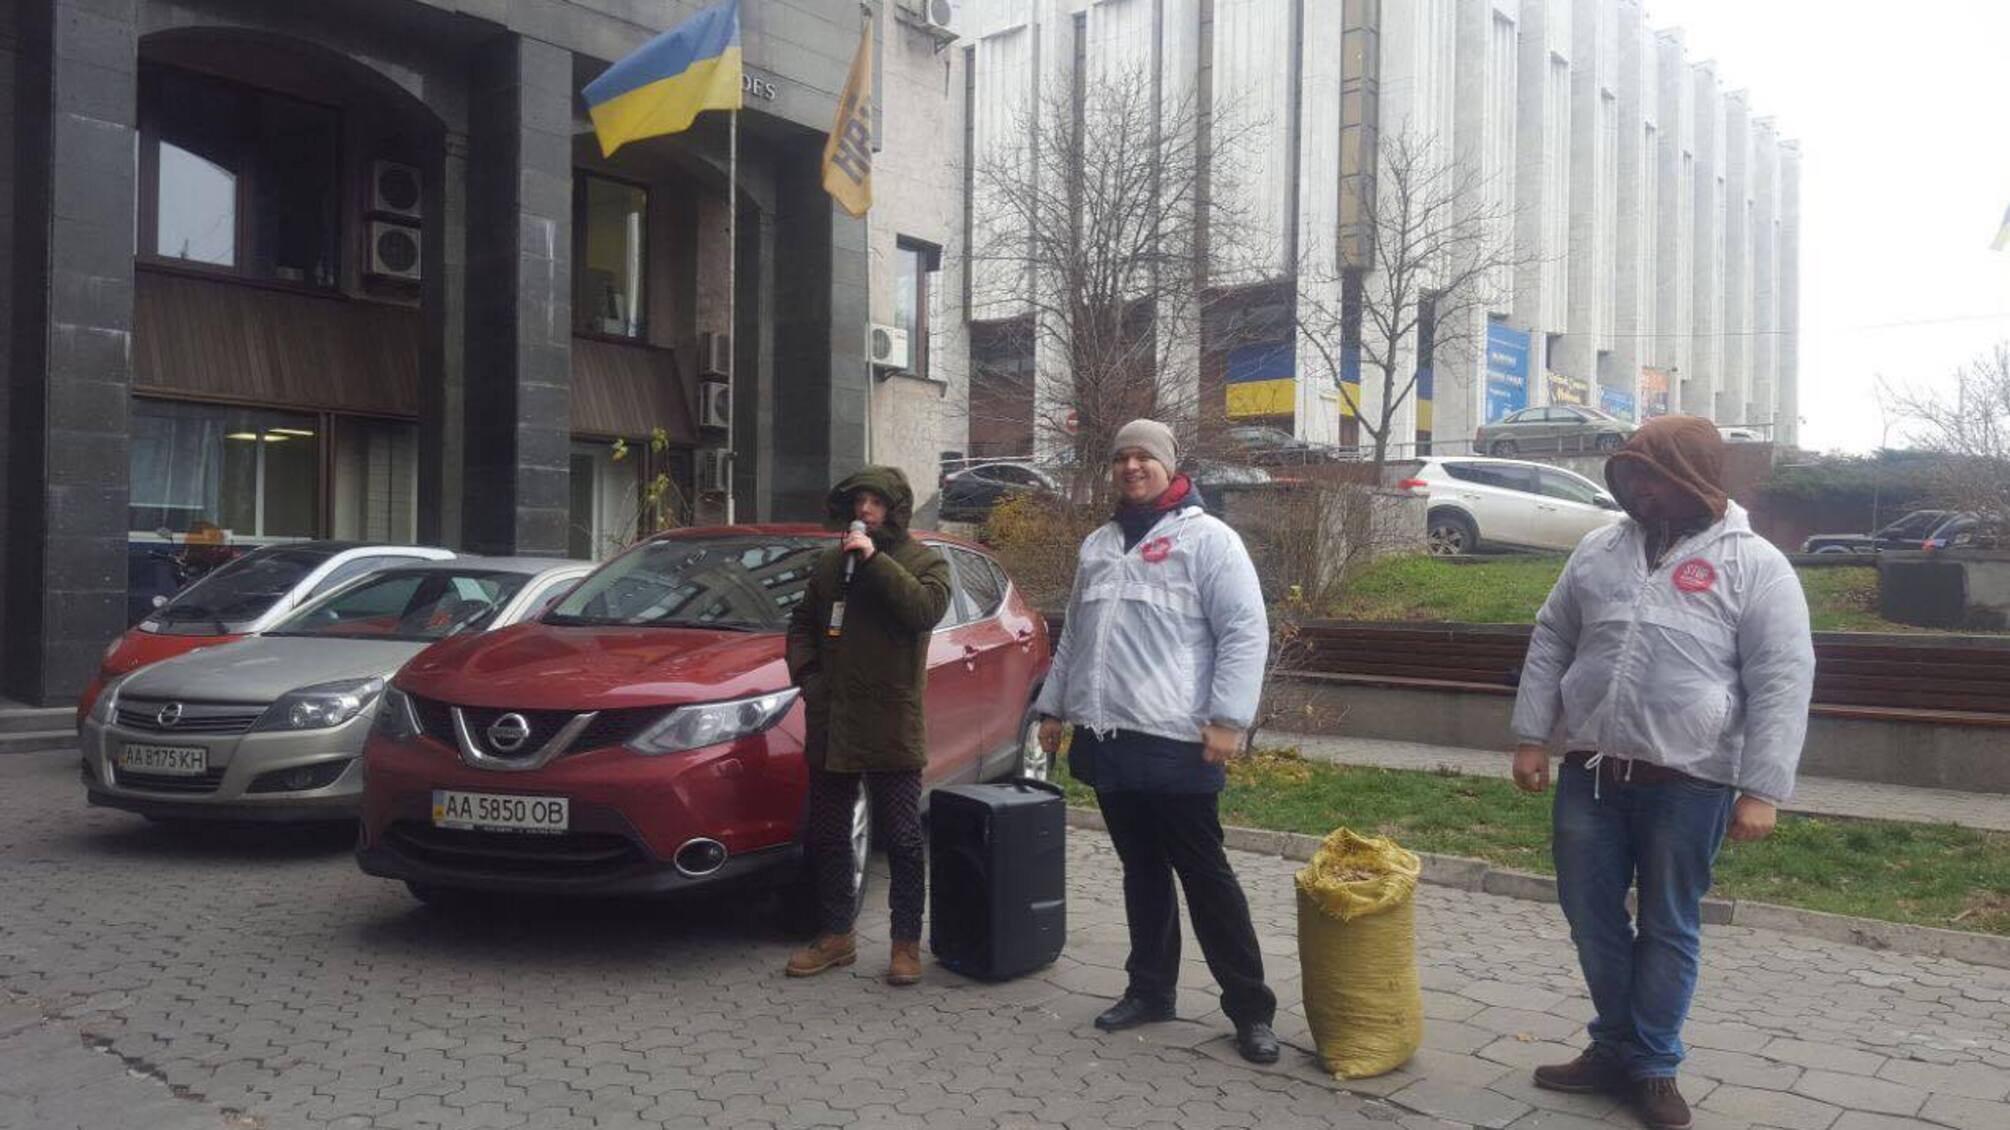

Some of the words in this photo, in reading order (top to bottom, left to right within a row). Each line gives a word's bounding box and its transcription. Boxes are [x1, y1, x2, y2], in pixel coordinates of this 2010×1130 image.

[127, 746, 143, 766] AA
[146, 748, 176, 769] 8175
[180, 750, 203, 769] KH
[446, 795, 473, 820] AA
[478, 797, 526, 822] 5850
[532, 801, 564, 824] OB
